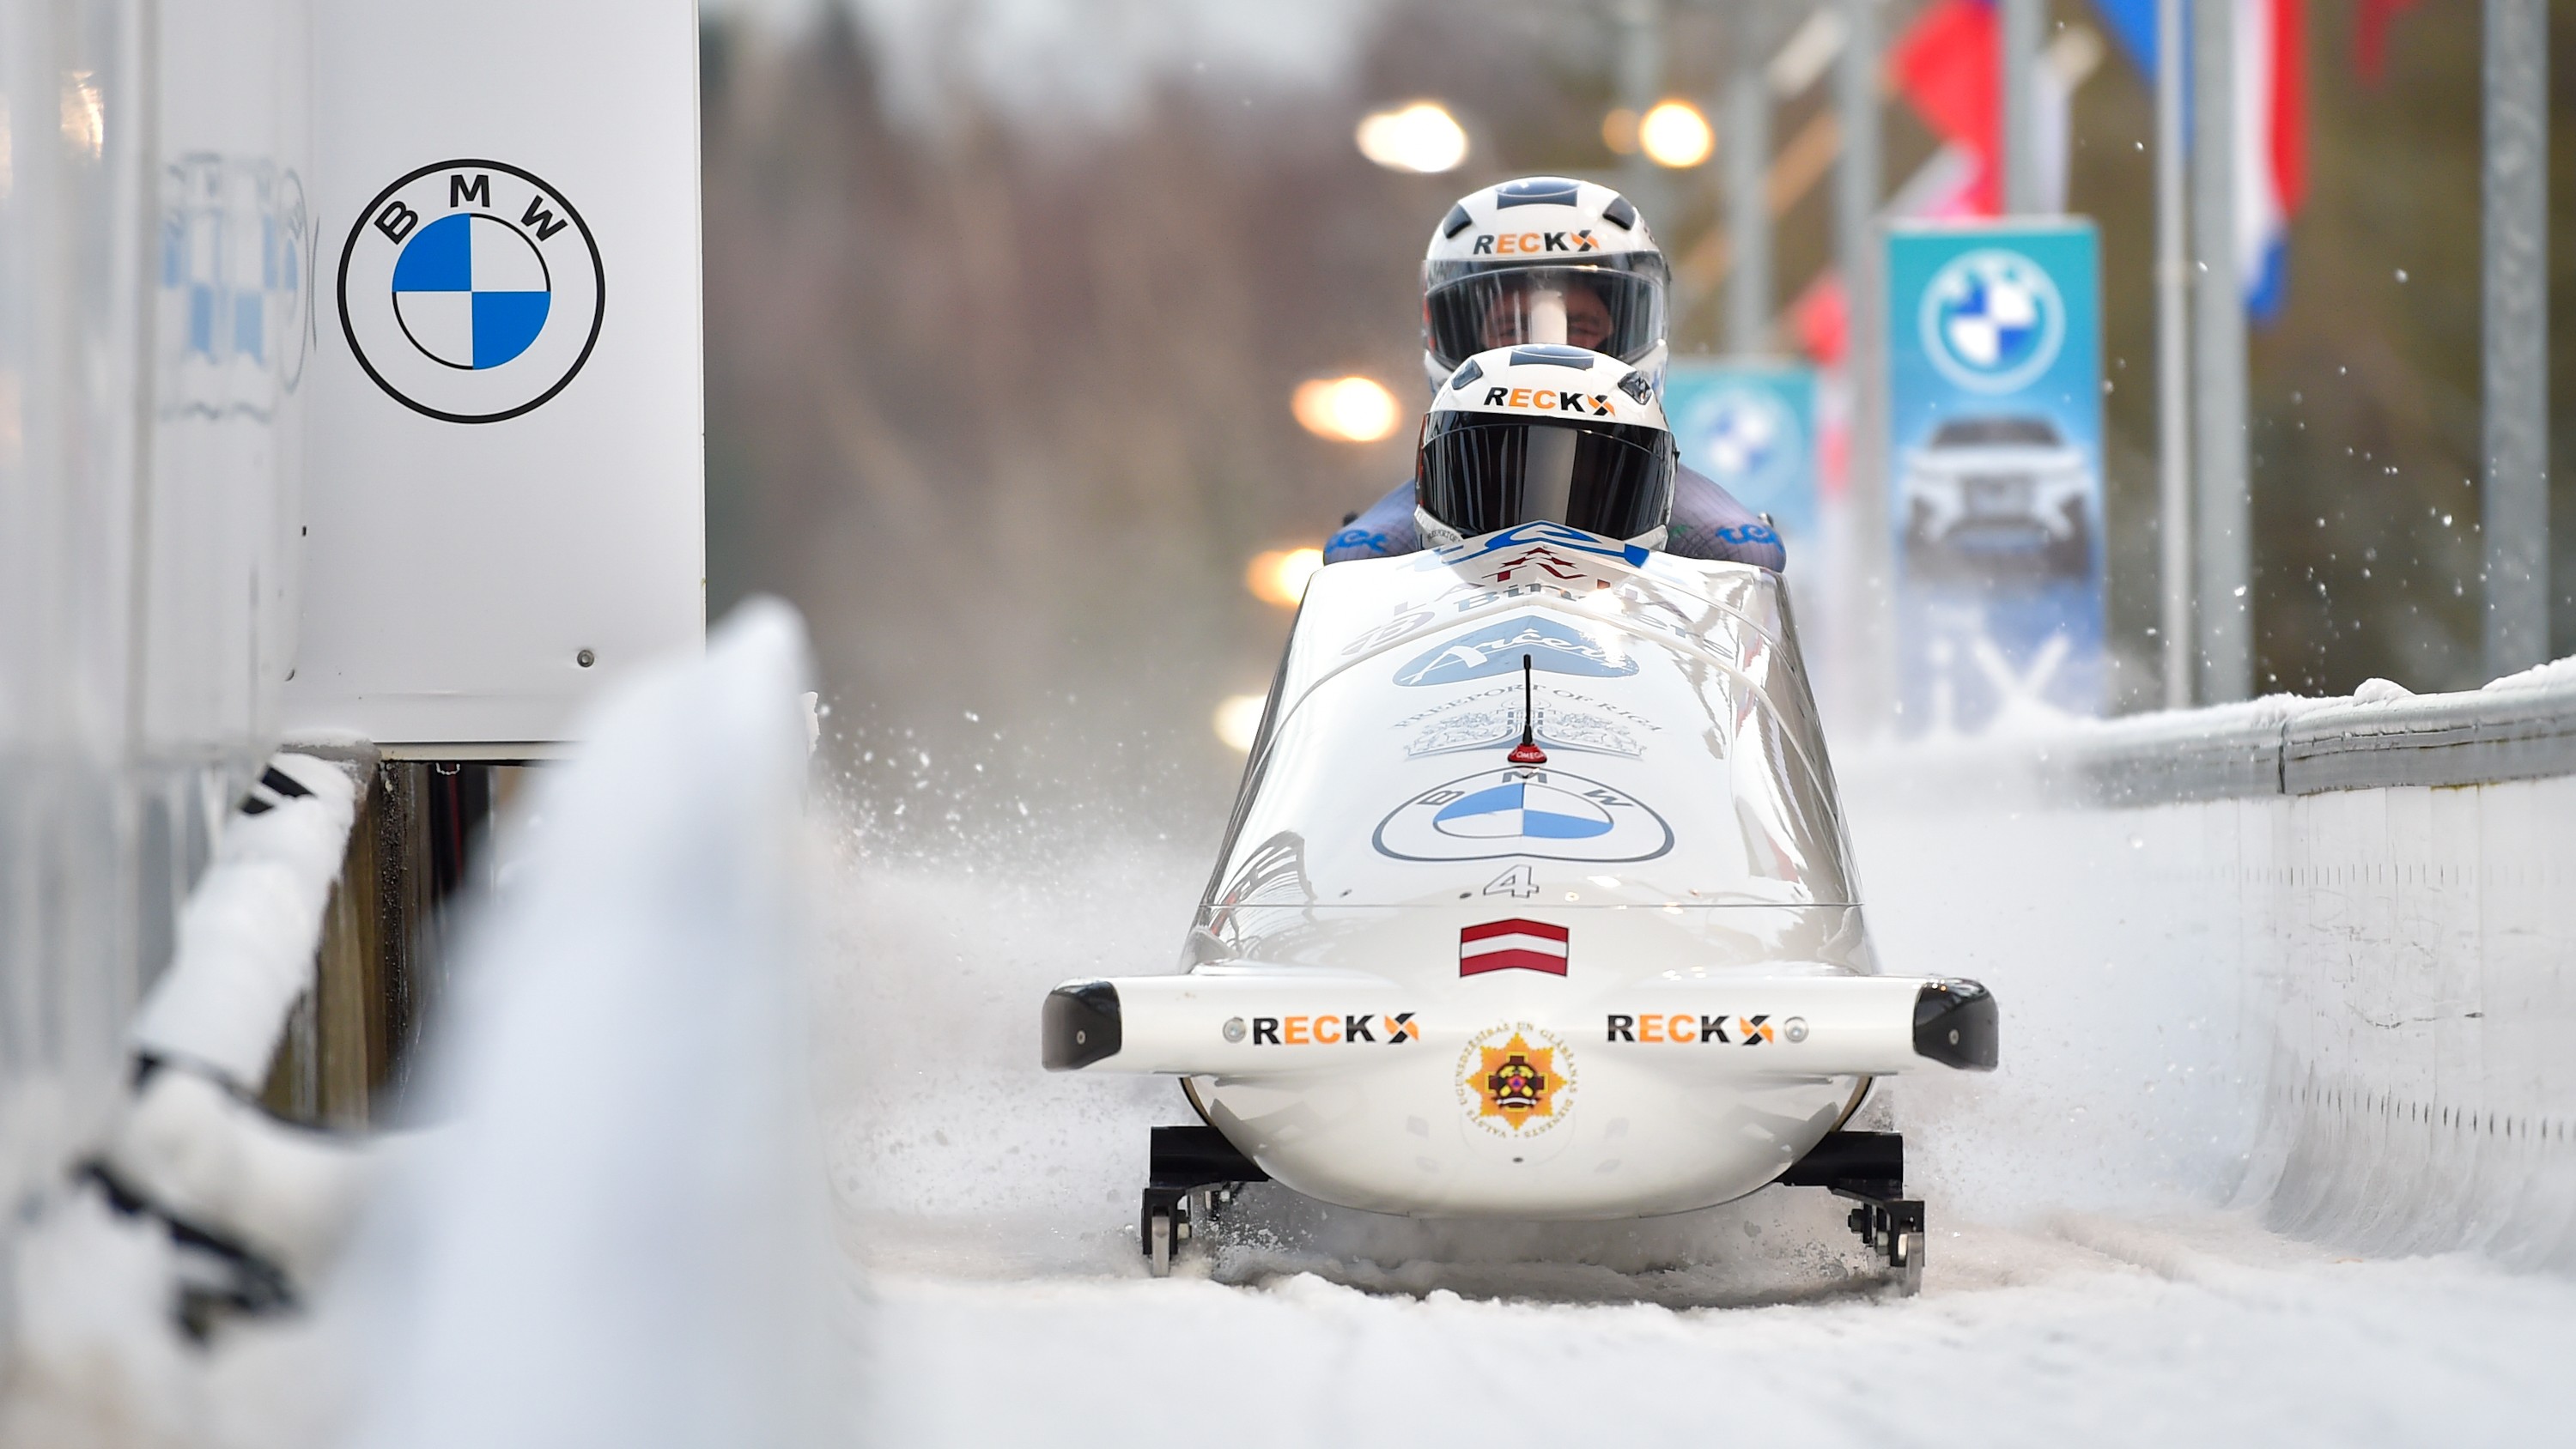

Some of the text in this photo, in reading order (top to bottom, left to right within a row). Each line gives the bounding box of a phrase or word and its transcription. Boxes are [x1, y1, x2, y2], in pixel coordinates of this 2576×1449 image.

[374, 174, 568, 245] BMW
[1394, 684, 1662, 731] FREEPORT OF RIGA
[1418, 771, 1635, 807] BMW
[1482, 864, 1540, 899] 4
